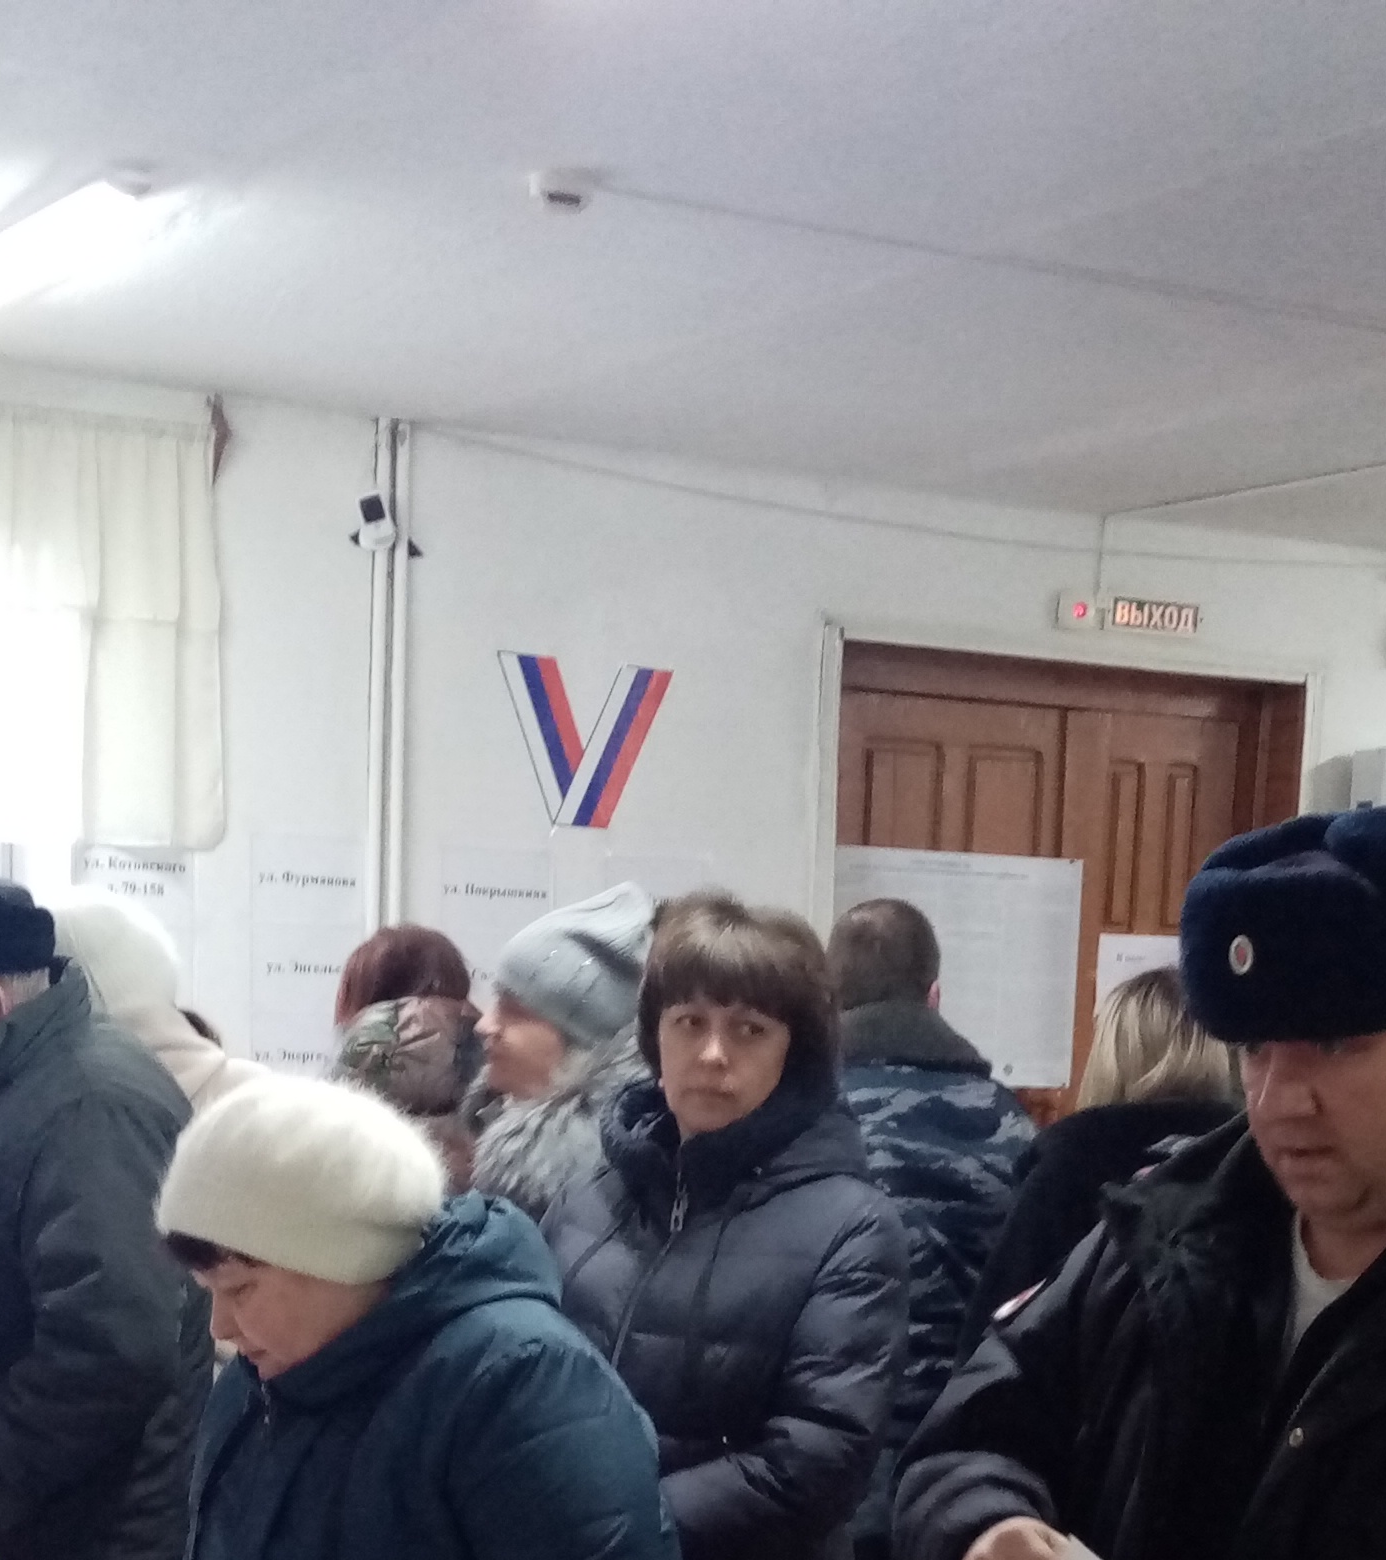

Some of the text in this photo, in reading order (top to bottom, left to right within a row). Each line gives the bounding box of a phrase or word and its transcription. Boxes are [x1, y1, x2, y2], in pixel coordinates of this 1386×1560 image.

[1114, 600, 1195, 634] ВЫХОД
[108, 856, 186, 874] Котовского
[281, 869, 356, 888] Фурманова
[464, 882, 547, 900] Покрышкина
